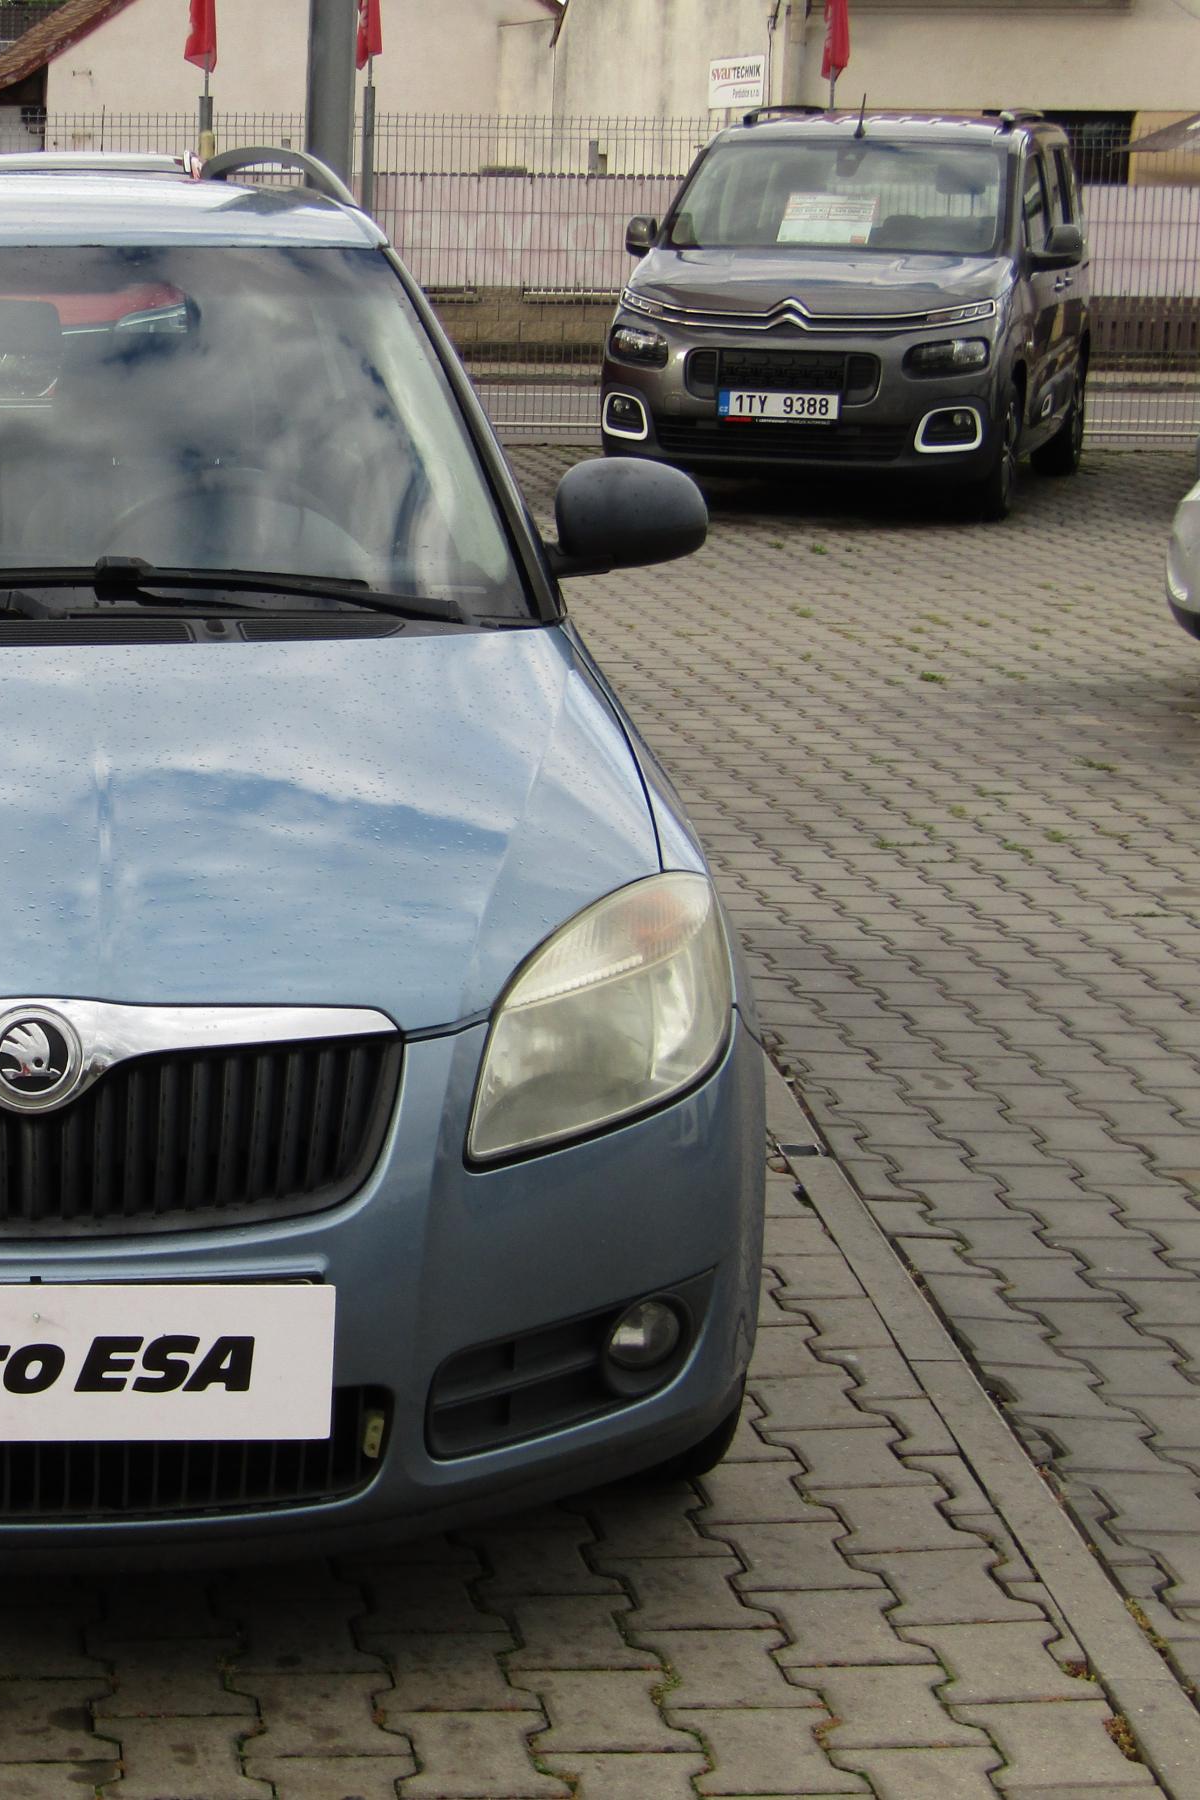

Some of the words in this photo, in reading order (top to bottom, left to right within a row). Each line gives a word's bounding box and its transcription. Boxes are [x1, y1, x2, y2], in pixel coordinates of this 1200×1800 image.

[735, 394, 768, 414] 1TY
[783, 397, 829, 416] 9388
[74, 1335, 255, 1393] ESA
